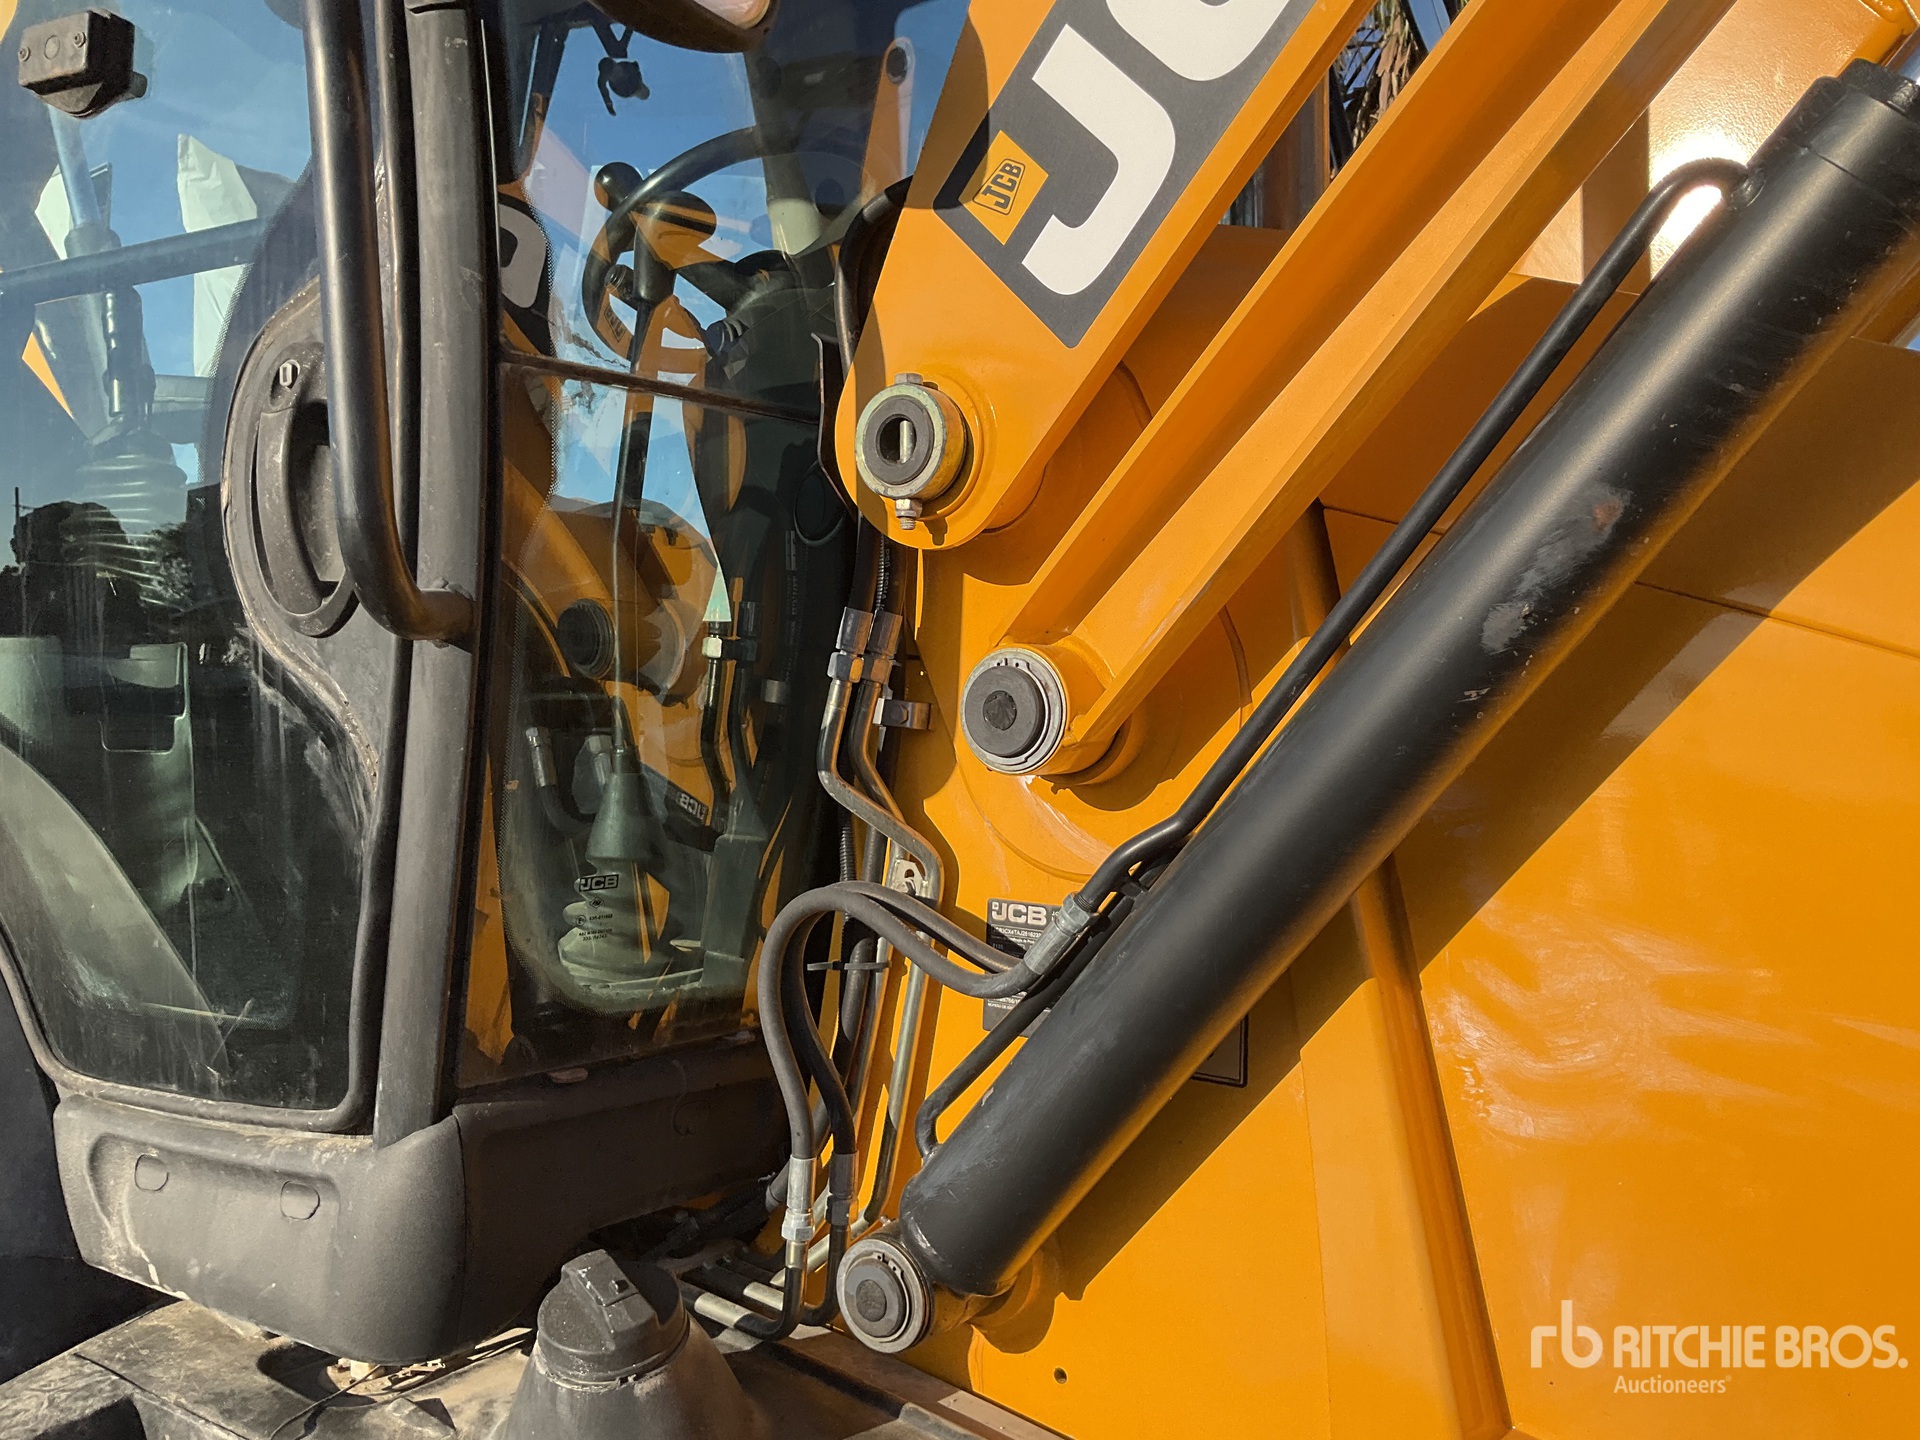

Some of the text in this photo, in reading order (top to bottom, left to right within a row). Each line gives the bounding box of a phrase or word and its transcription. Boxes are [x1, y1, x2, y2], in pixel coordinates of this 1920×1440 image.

[981, 163, 1022, 209] JCB
[580, 875, 618, 890] JCB
[991, 901, 1047, 926] JCB
